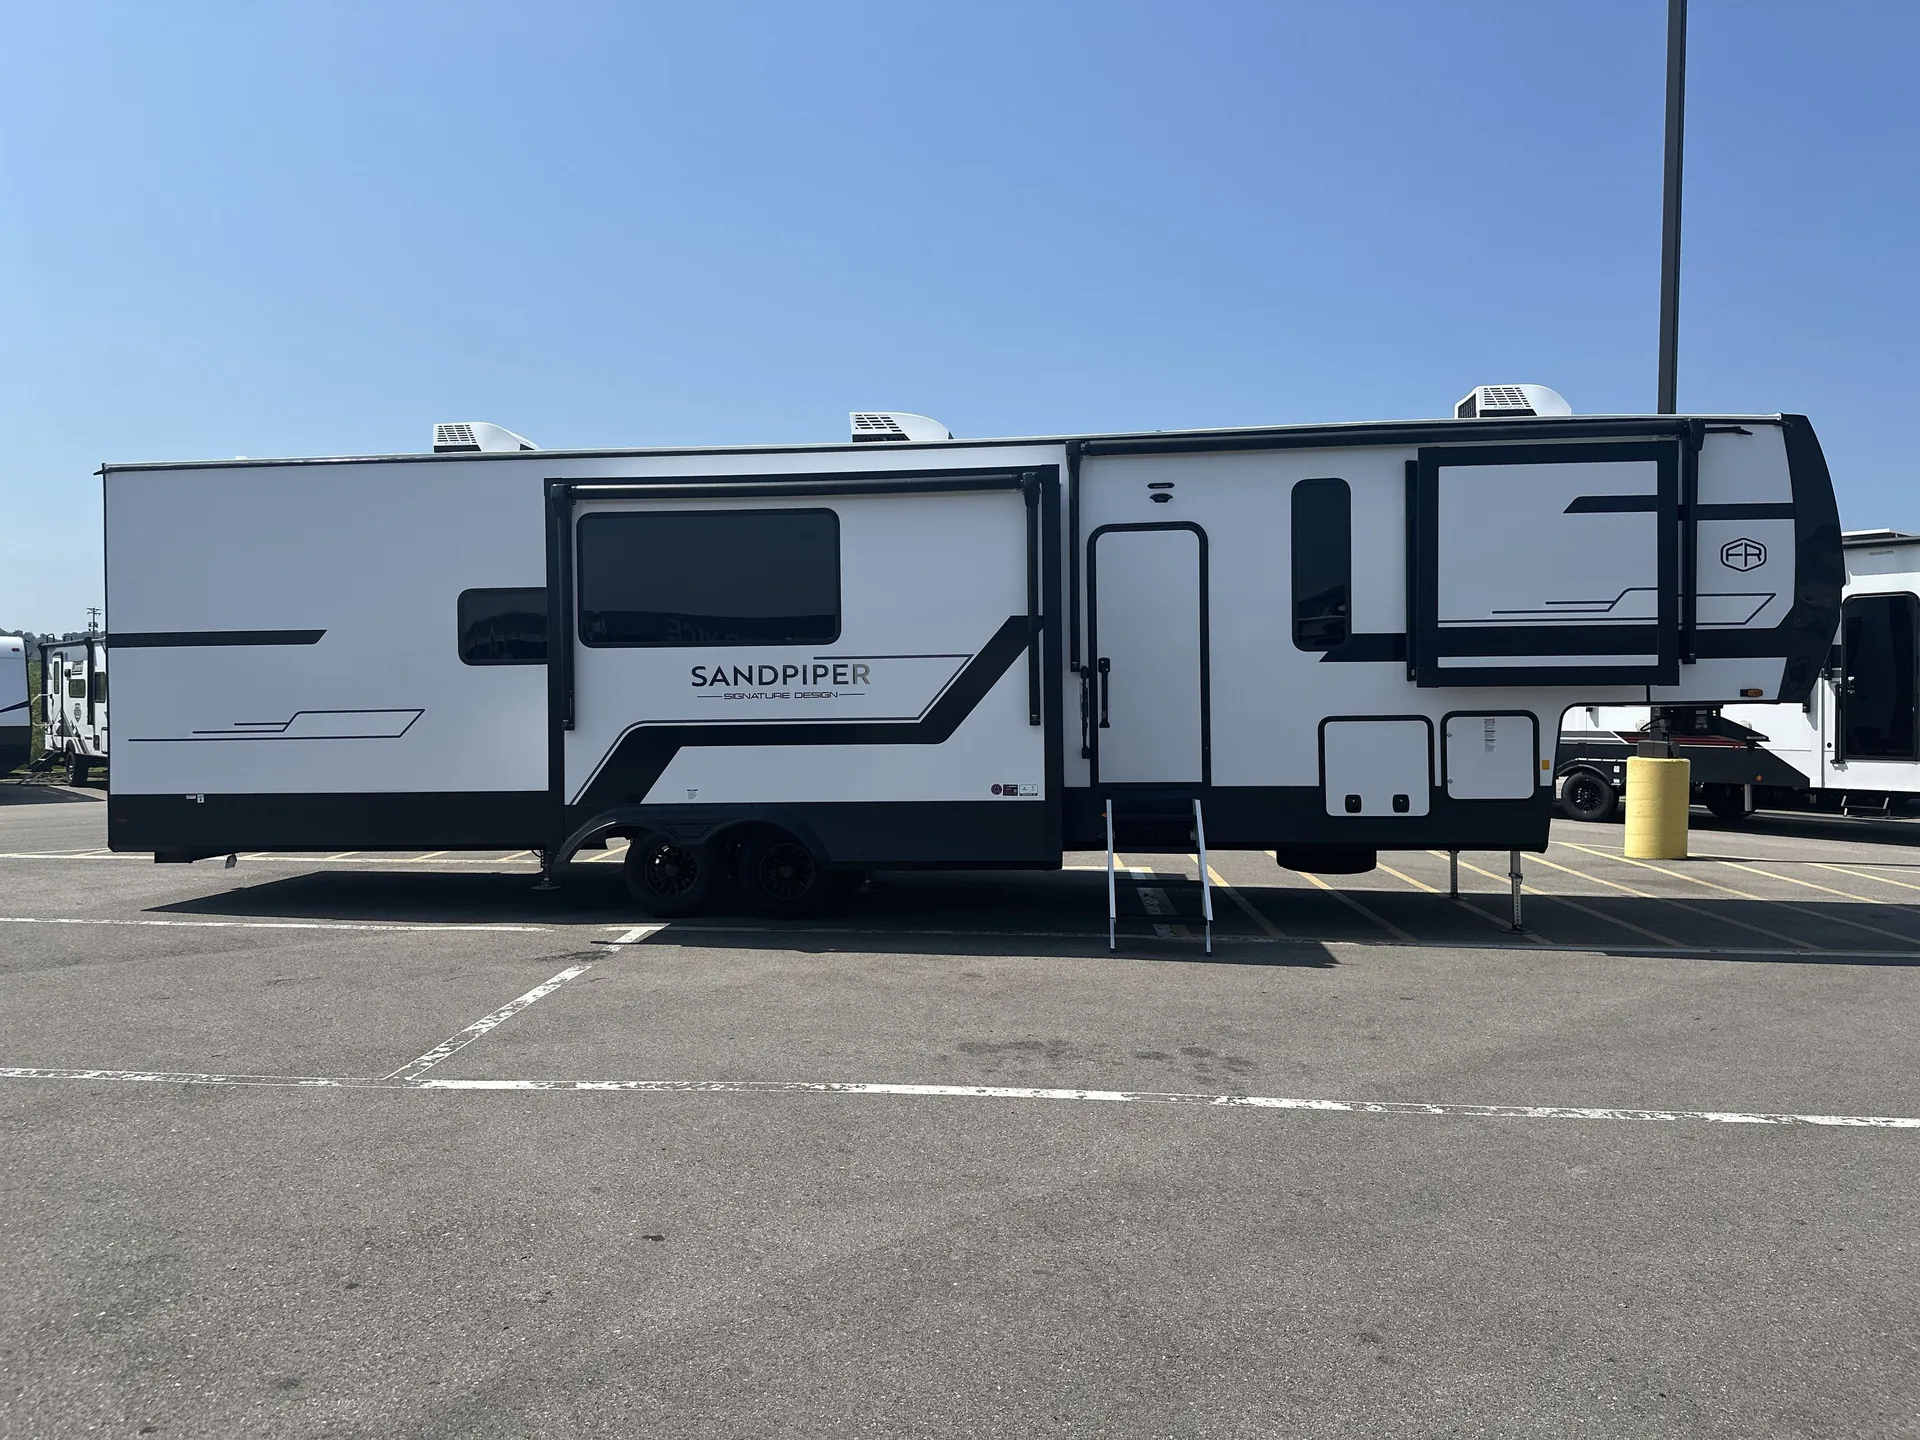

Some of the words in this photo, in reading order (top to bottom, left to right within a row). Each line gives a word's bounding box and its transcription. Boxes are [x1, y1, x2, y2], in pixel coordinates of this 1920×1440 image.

[691, 664, 871, 687] SANDPIPER
[723, 692, 791, 700] SIGNATURE
[794, 691, 839, 699] DESIGN
